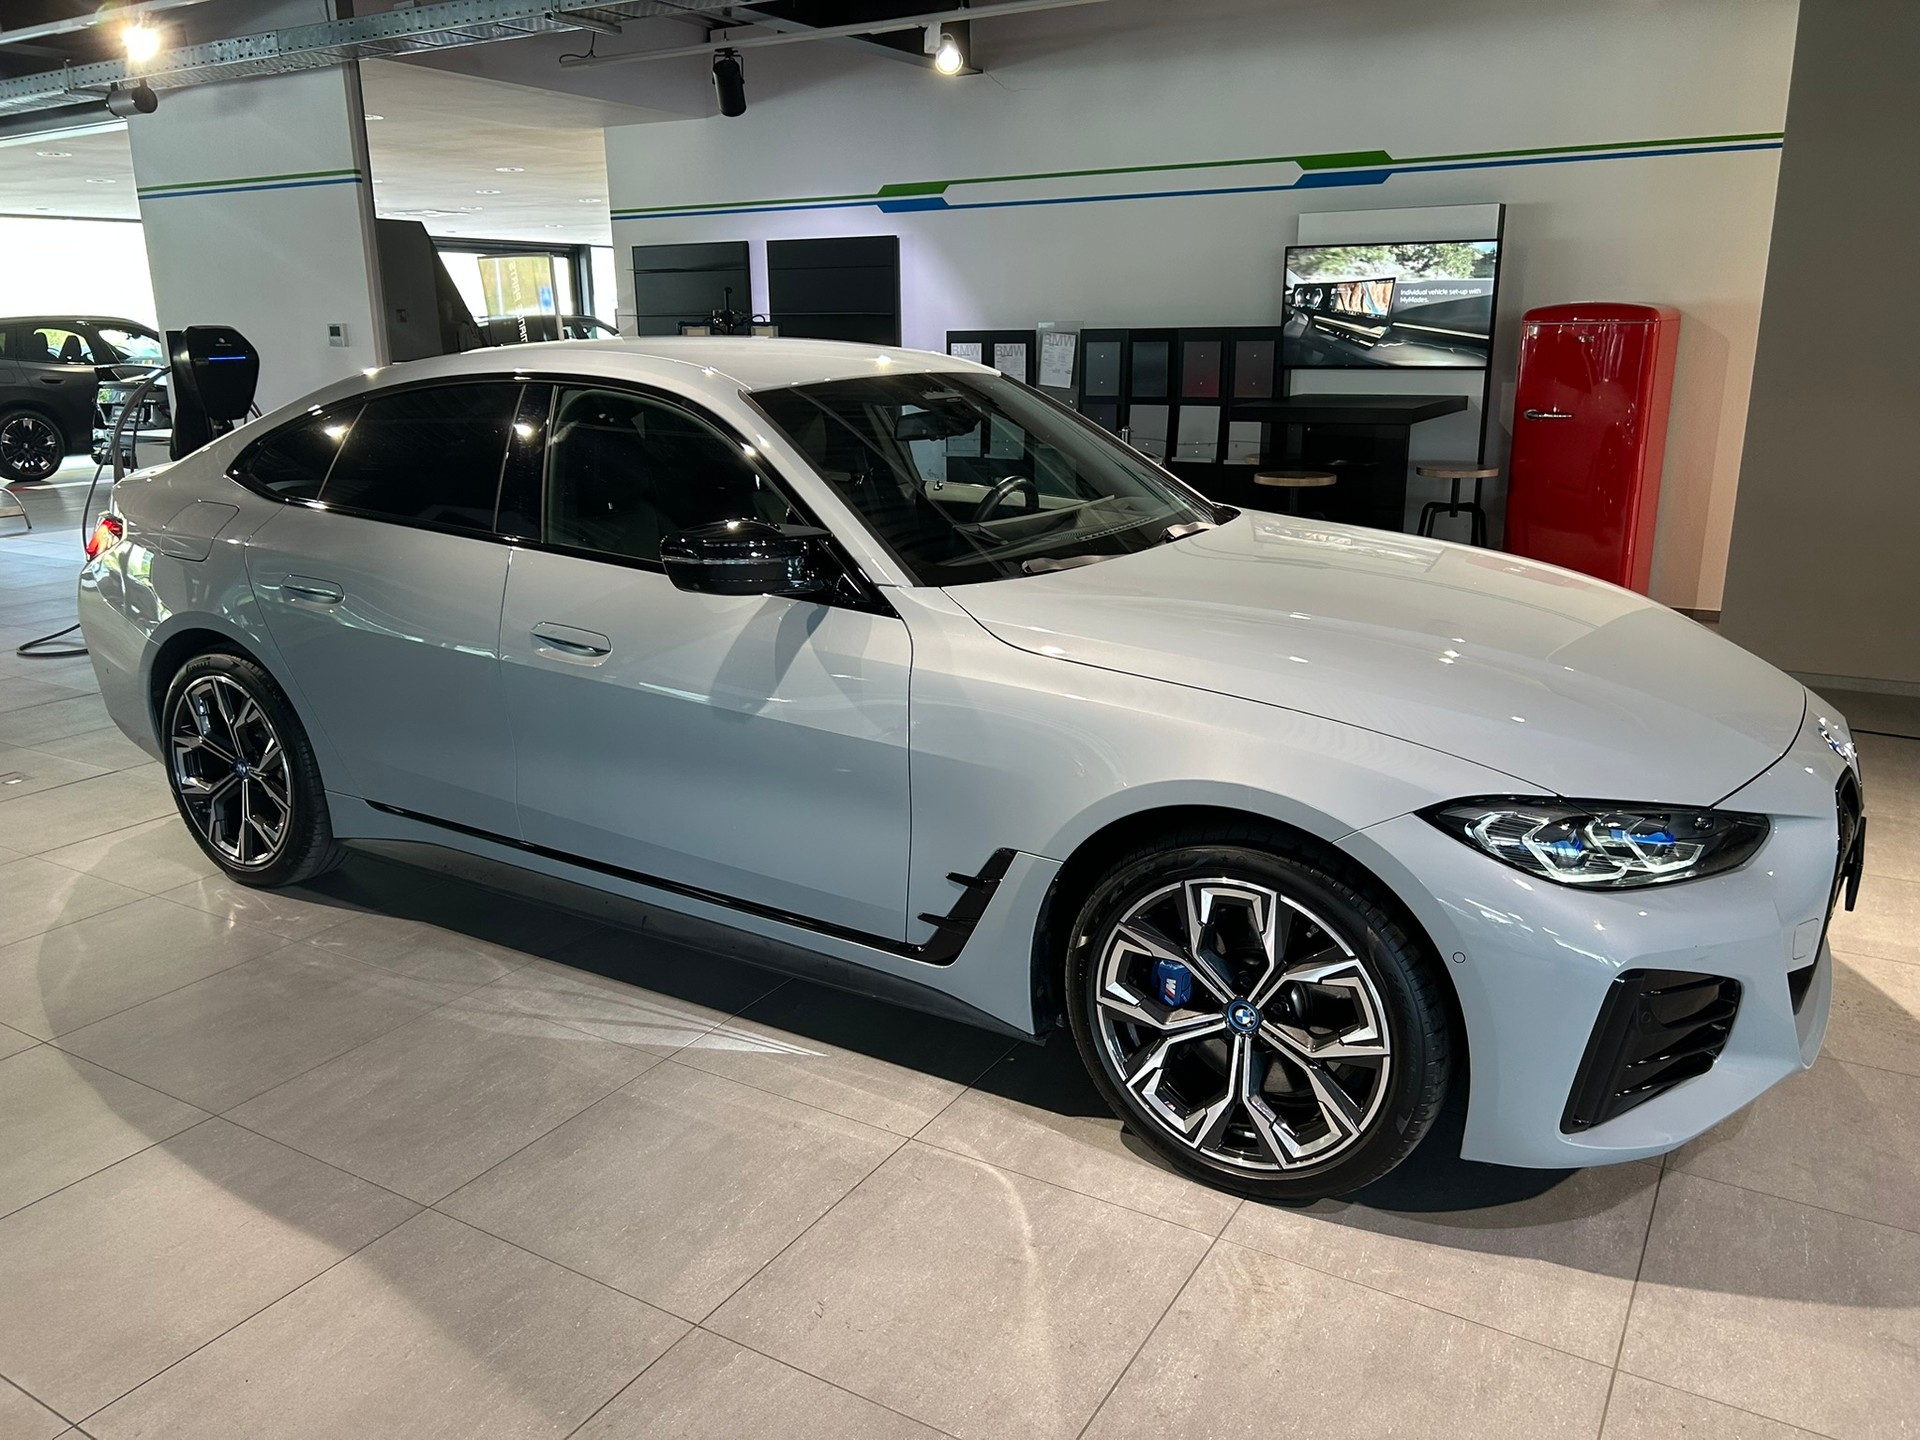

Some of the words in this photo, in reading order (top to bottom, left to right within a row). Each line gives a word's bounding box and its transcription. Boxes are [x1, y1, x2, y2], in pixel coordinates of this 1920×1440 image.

[1449, 288, 1468, 296] set-up
[1044, 334, 1074, 347] BMW
[953, 344, 980, 356] BMW
[995, 345, 1025, 356] BMW
